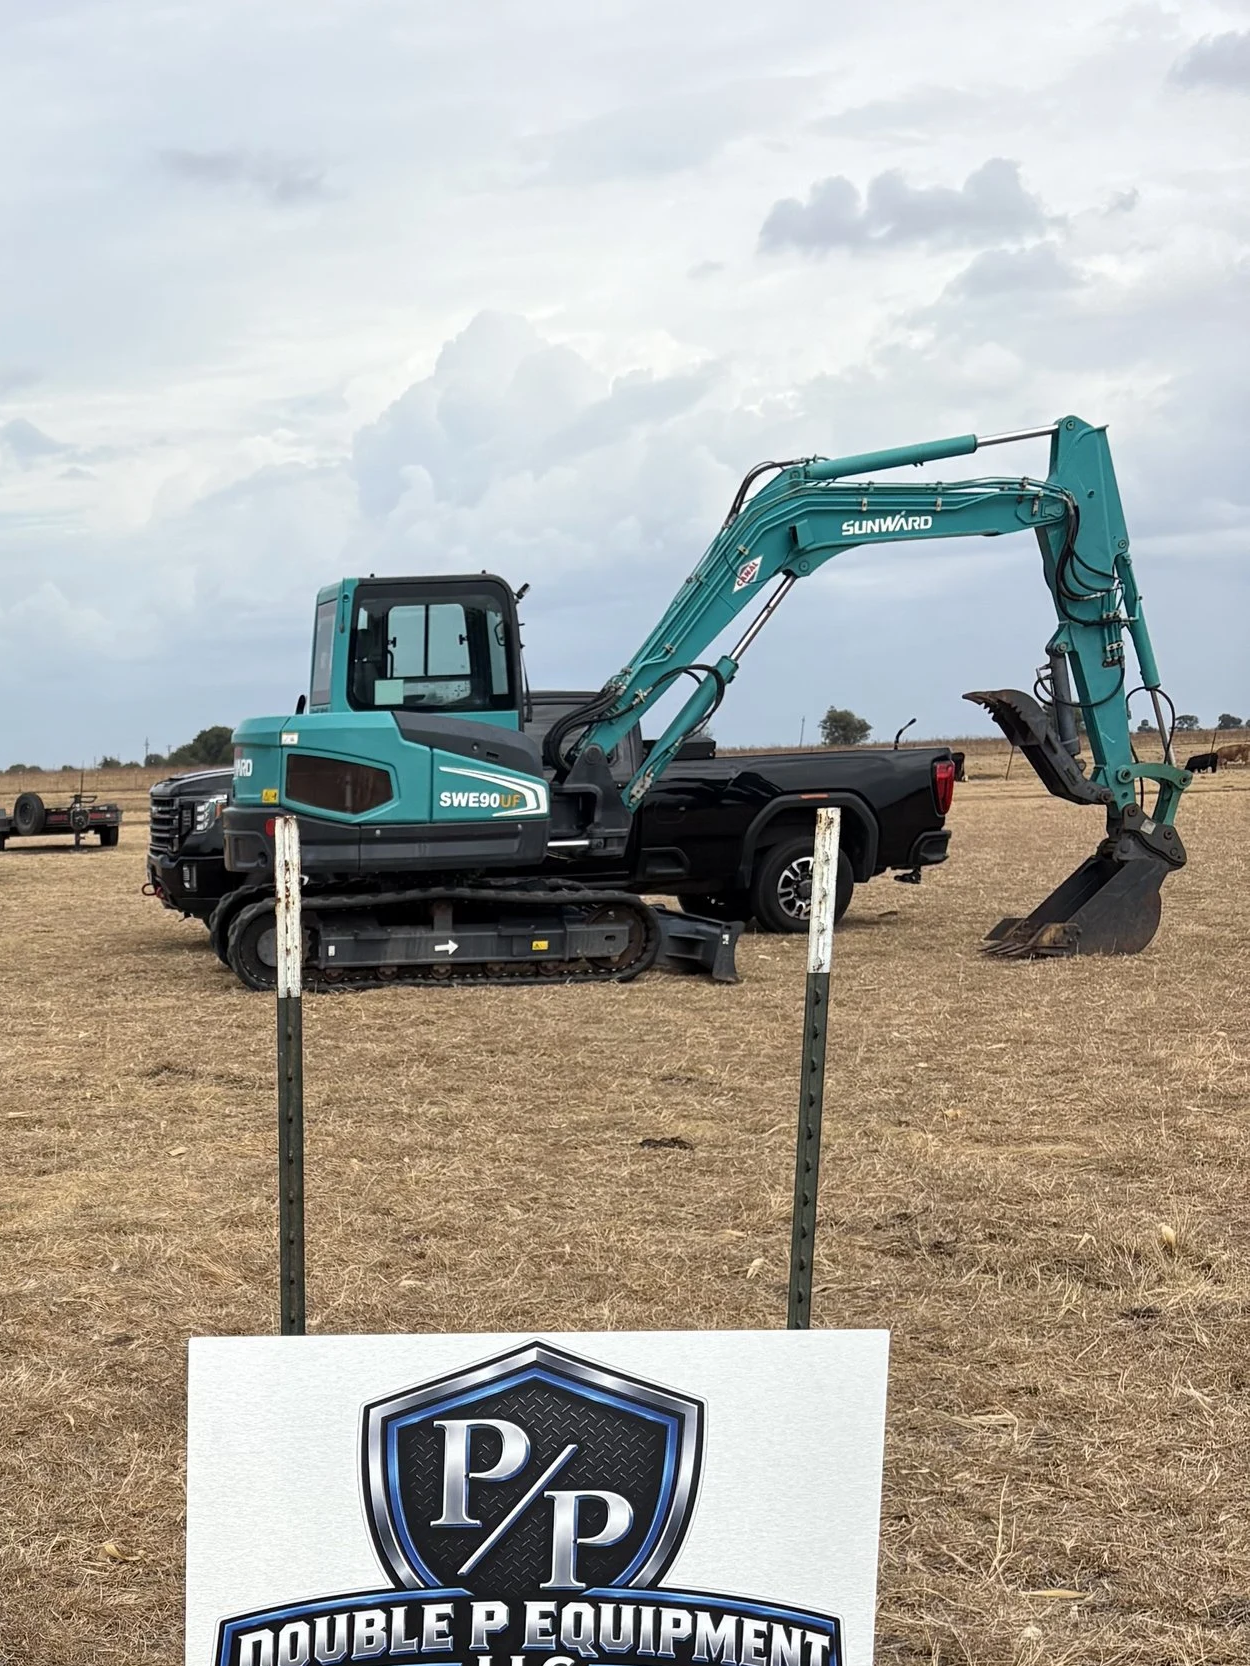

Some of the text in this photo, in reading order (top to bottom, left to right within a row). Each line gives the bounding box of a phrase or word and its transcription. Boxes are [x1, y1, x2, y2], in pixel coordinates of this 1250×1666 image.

[841, 511, 933, 536] SUNWARD
[736, 561, 759, 587] CANAL
[439, 791, 521, 808] SWE90UF
[470, 1600, 511, 1650] P
